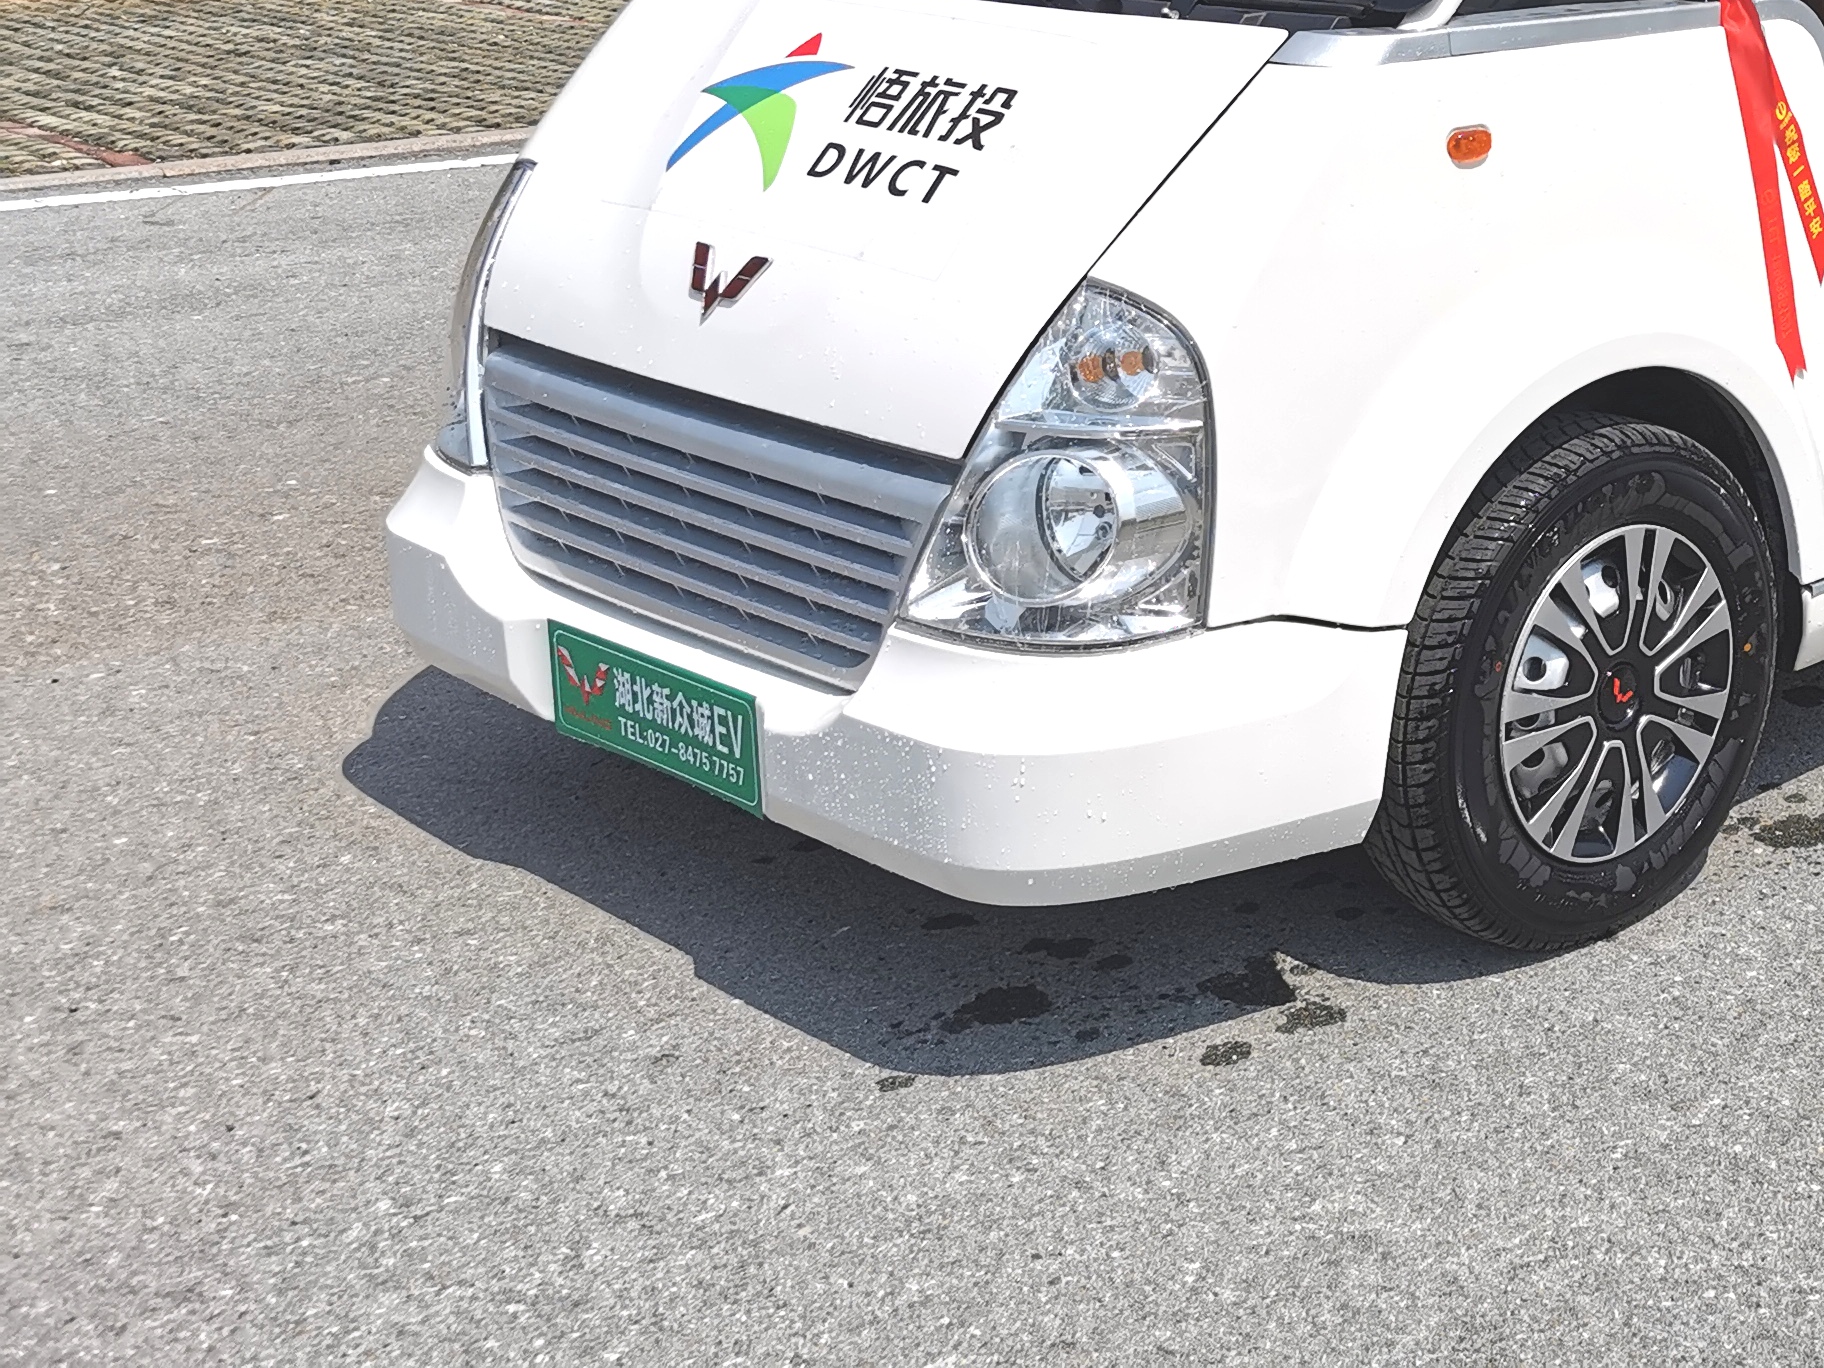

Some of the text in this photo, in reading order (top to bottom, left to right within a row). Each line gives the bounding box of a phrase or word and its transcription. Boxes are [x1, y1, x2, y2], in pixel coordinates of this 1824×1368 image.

[843, 66, 1018, 151] 悟旅投
[806, 142, 960, 204] DWCT
